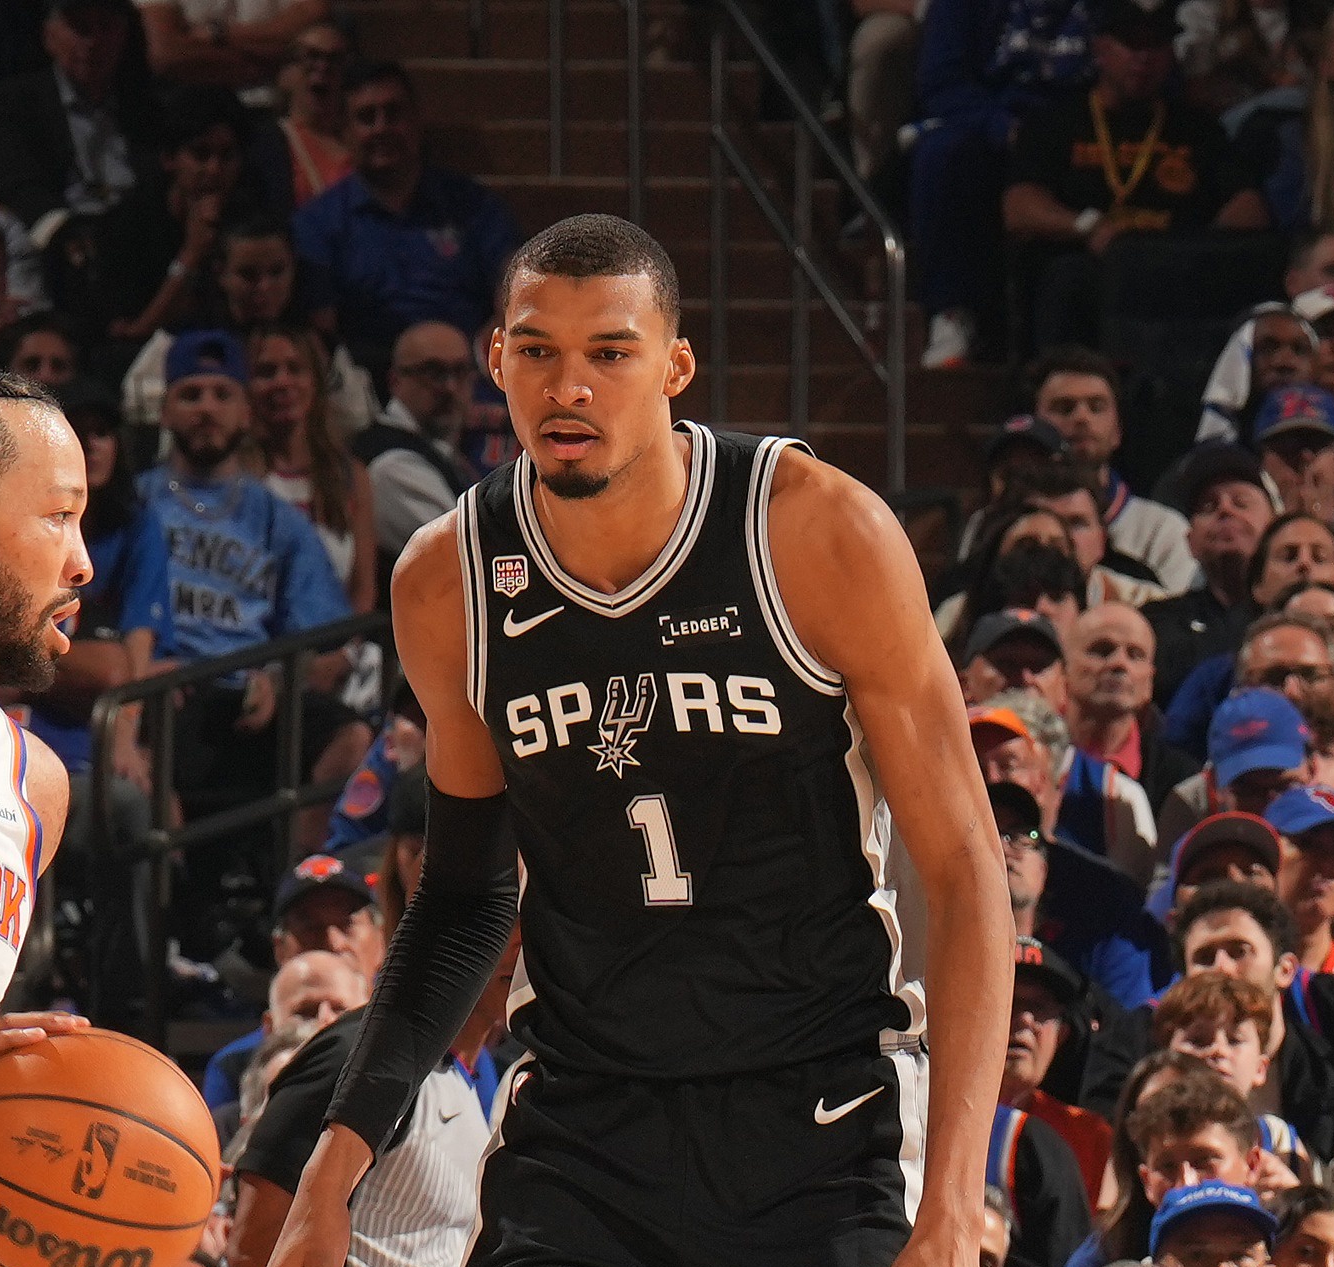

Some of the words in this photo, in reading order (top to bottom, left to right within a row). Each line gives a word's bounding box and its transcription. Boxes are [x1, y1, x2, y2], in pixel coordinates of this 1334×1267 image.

[496, 561, 523, 572] USA
[496, 576, 525, 588] 250
[670, 615, 730, 637] LEDGER
[506, 672, 783, 774] SPURS
[625, 793, 694, 906] 1
